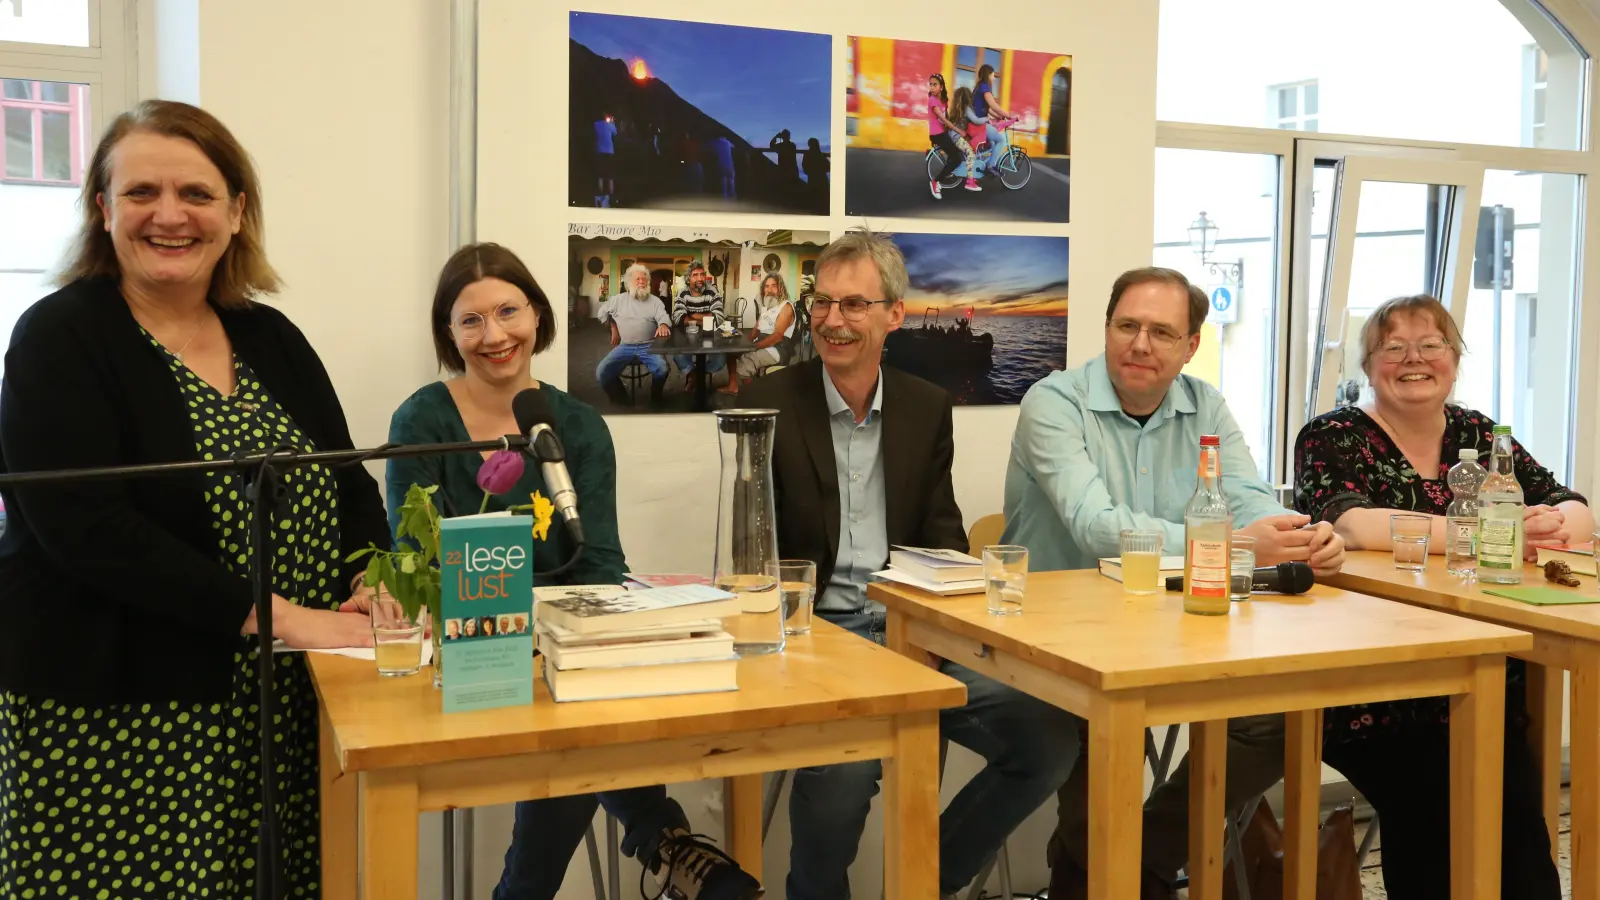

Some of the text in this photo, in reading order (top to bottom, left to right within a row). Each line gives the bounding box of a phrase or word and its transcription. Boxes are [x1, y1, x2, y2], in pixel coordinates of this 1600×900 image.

[568, 223, 662, 236] Bar Amore Mio
[465, 541, 526, 573] lese
[458, 568, 515, 602] lust
